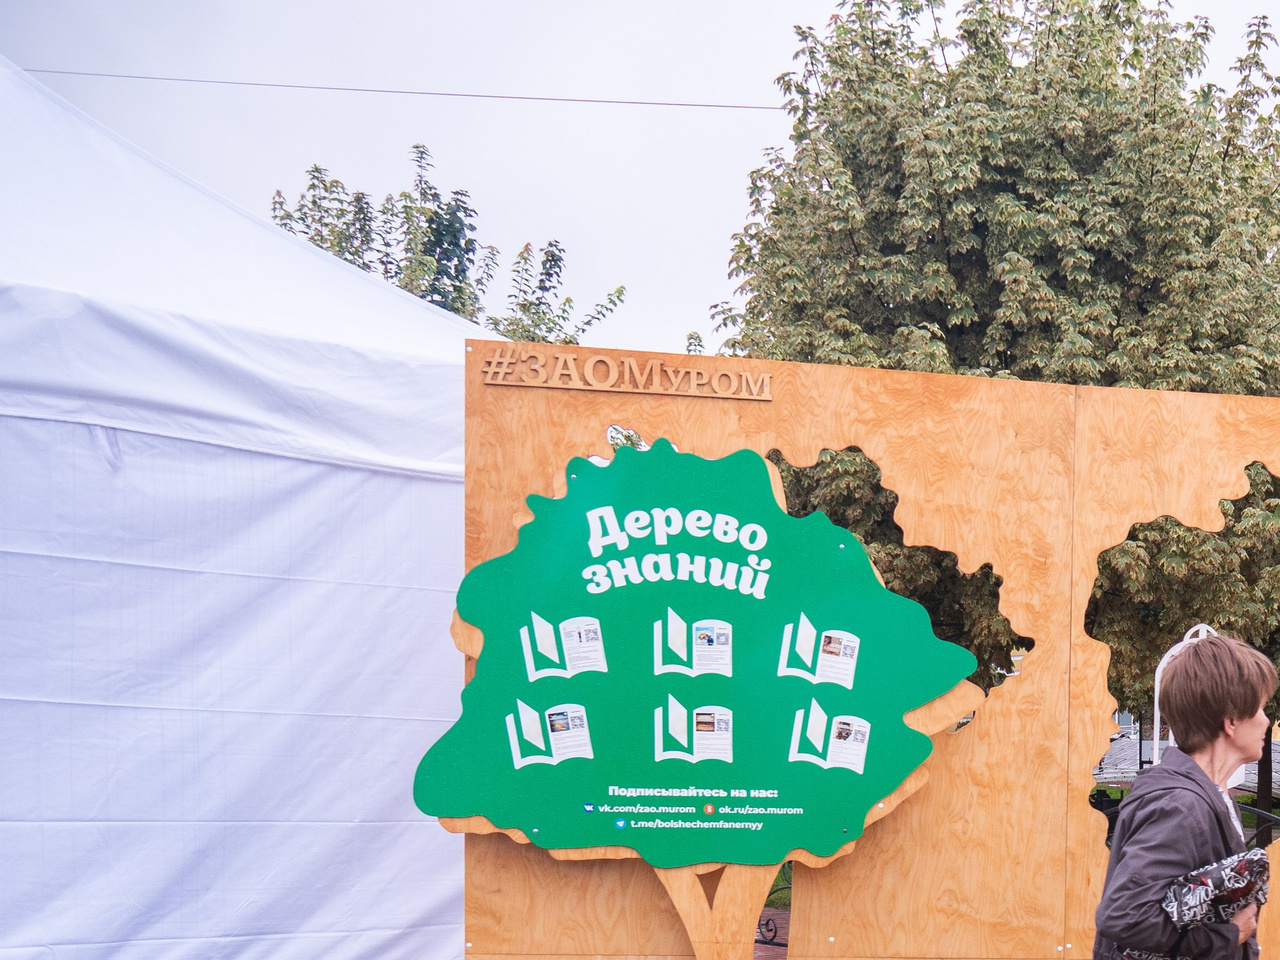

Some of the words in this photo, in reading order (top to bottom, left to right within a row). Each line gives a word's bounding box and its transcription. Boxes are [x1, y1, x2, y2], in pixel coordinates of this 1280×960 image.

[586, 506, 768, 557] Дерево
[581, 553, 772, 600] знаний
[608, 786, 727, 797] Подписывайтесь
[730, 788, 747, 798] на
[750, 788, 778, 798] нас:
[598, 803, 696, 814] vk.com/zao.murom
[718, 805, 804, 815] ok.ru/zao.murom
[630, 819, 763, 831] t.me/bolshechemfanernyy
